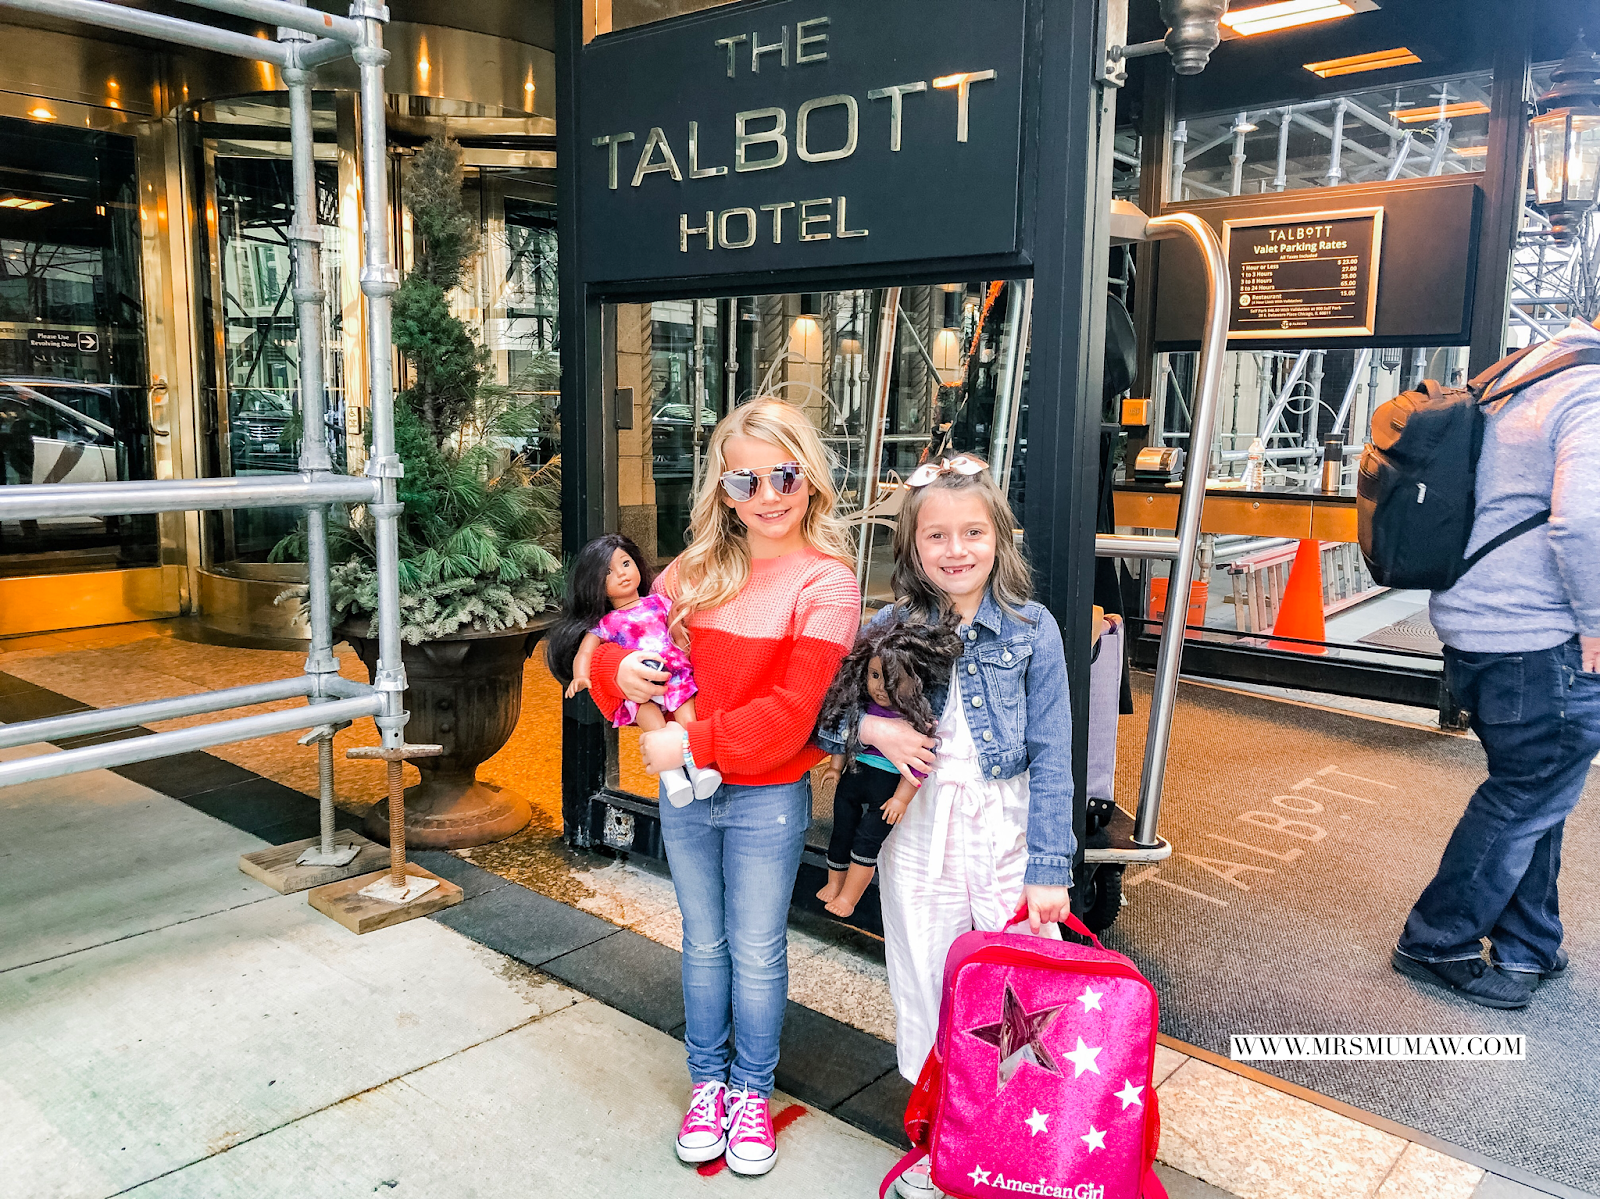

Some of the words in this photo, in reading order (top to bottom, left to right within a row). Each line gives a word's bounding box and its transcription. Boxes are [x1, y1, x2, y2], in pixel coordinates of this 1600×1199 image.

[714, 16, 830, 78] THE
[591, 68, 998, 191] TALBOTT
[678, 195, 870, 253] HOTEL
[1254, 244, 1278, 254] Valet
[1280, 242, 1318, 252] Parking
[1319, 240, 1348, 250] Rates
[1269, 225, 1333, 241] TALBOTT
[30, 340, 60, 348] Revolving
[1124, 763, 1400, 907] TALBOTT
